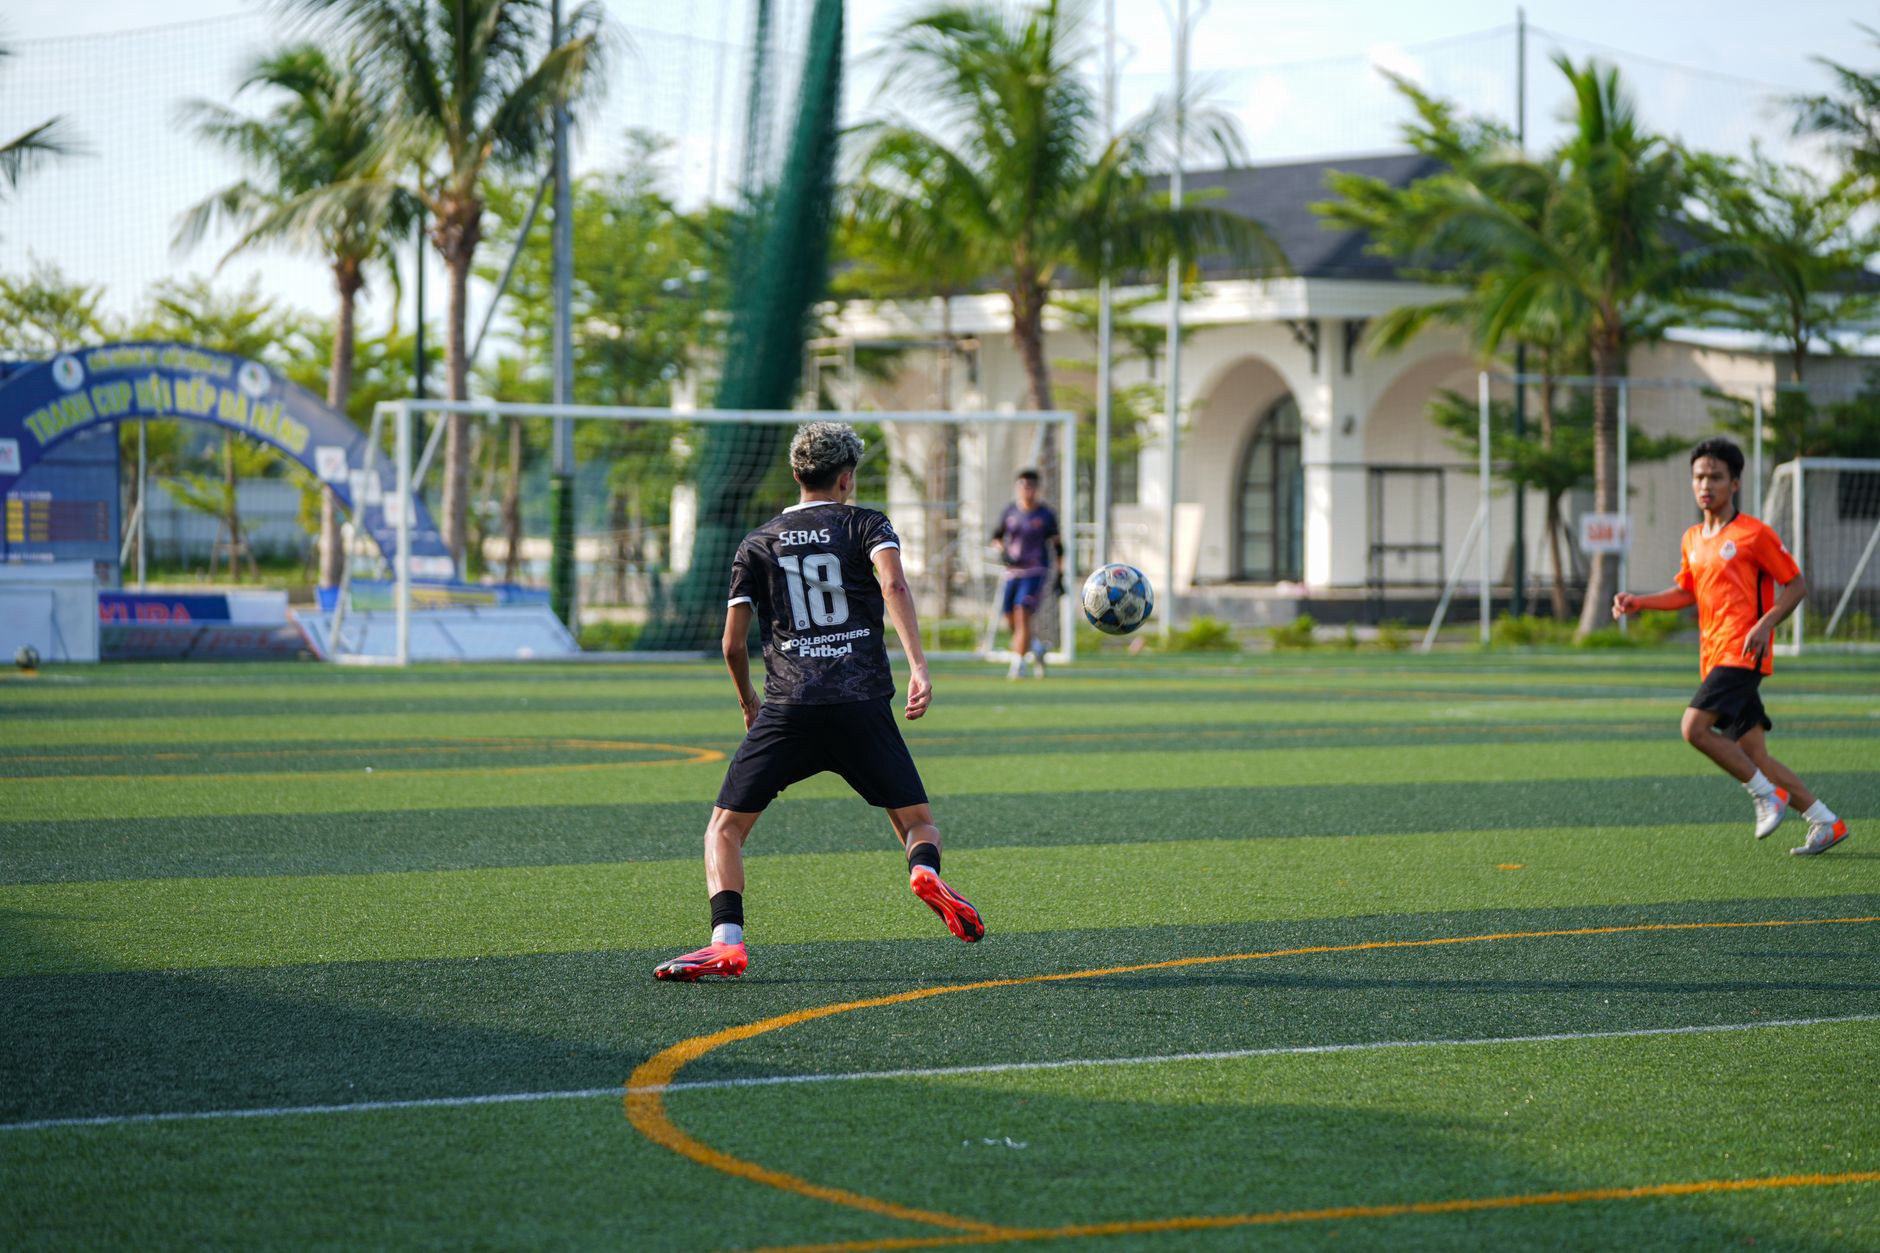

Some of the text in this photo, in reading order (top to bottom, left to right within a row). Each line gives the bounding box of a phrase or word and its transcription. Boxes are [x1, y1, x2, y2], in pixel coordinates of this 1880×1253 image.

[91, 381, 132, 417] CUP
[779, 528, 831, 547] SEBAS
[778, 553, 849, 630] 18
[799, 642, 853, 658] Futbol
